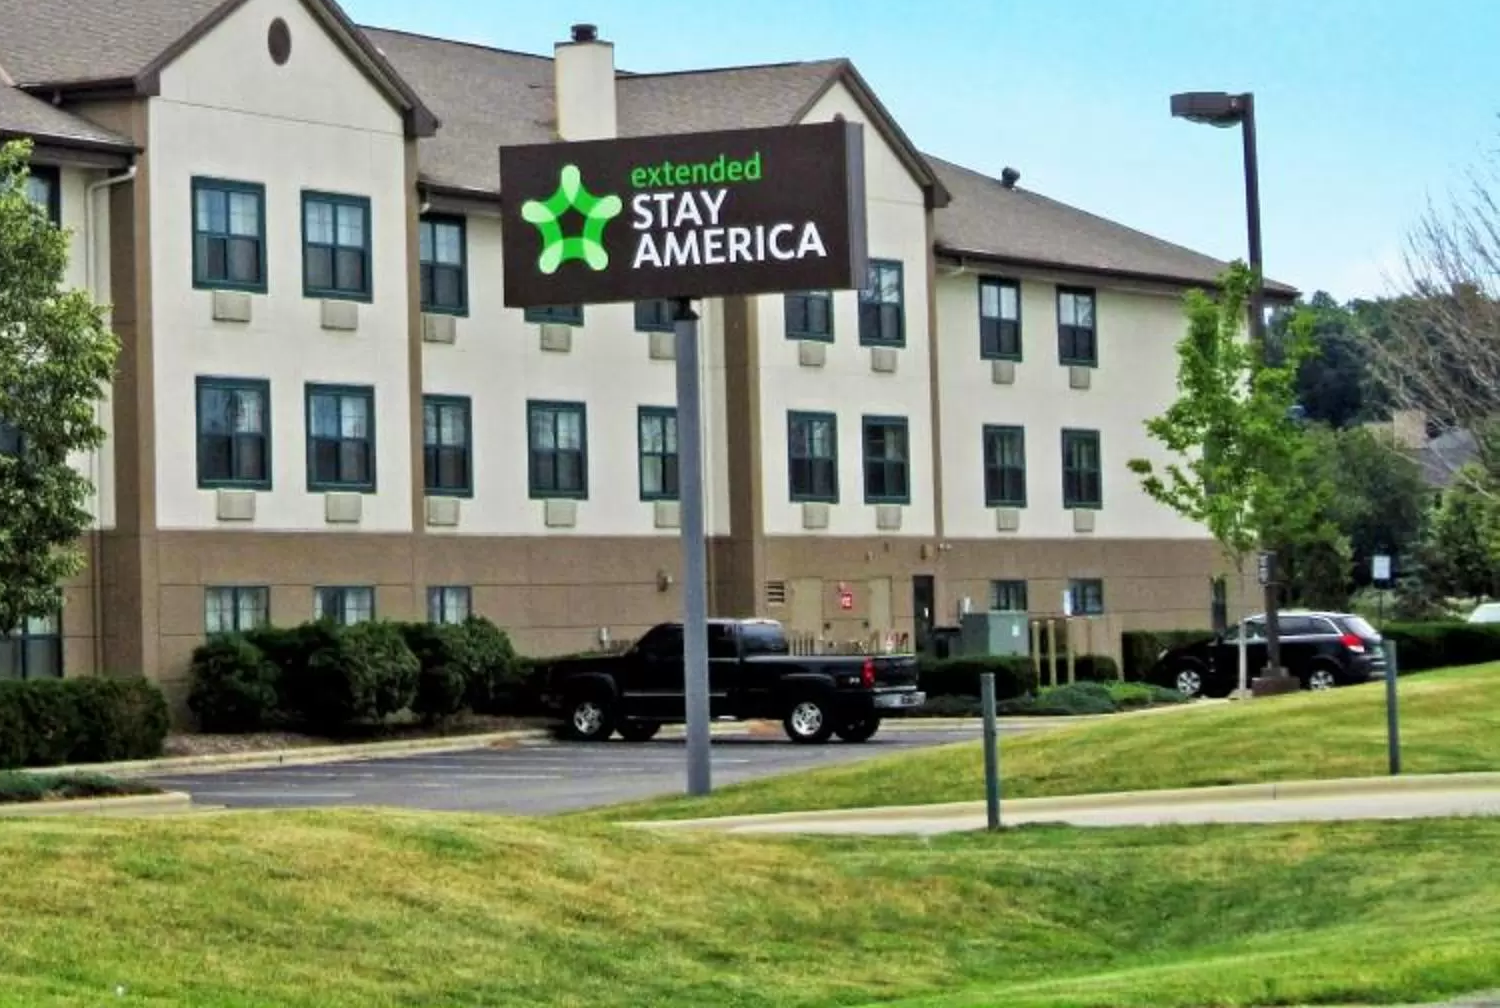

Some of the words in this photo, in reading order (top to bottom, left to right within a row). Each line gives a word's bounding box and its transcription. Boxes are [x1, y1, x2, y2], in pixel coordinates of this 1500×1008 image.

[631, 151, 762, 188] extended
[632, 189, 728, 230] STAY
[631, 221, 827, 269] AMERICA
